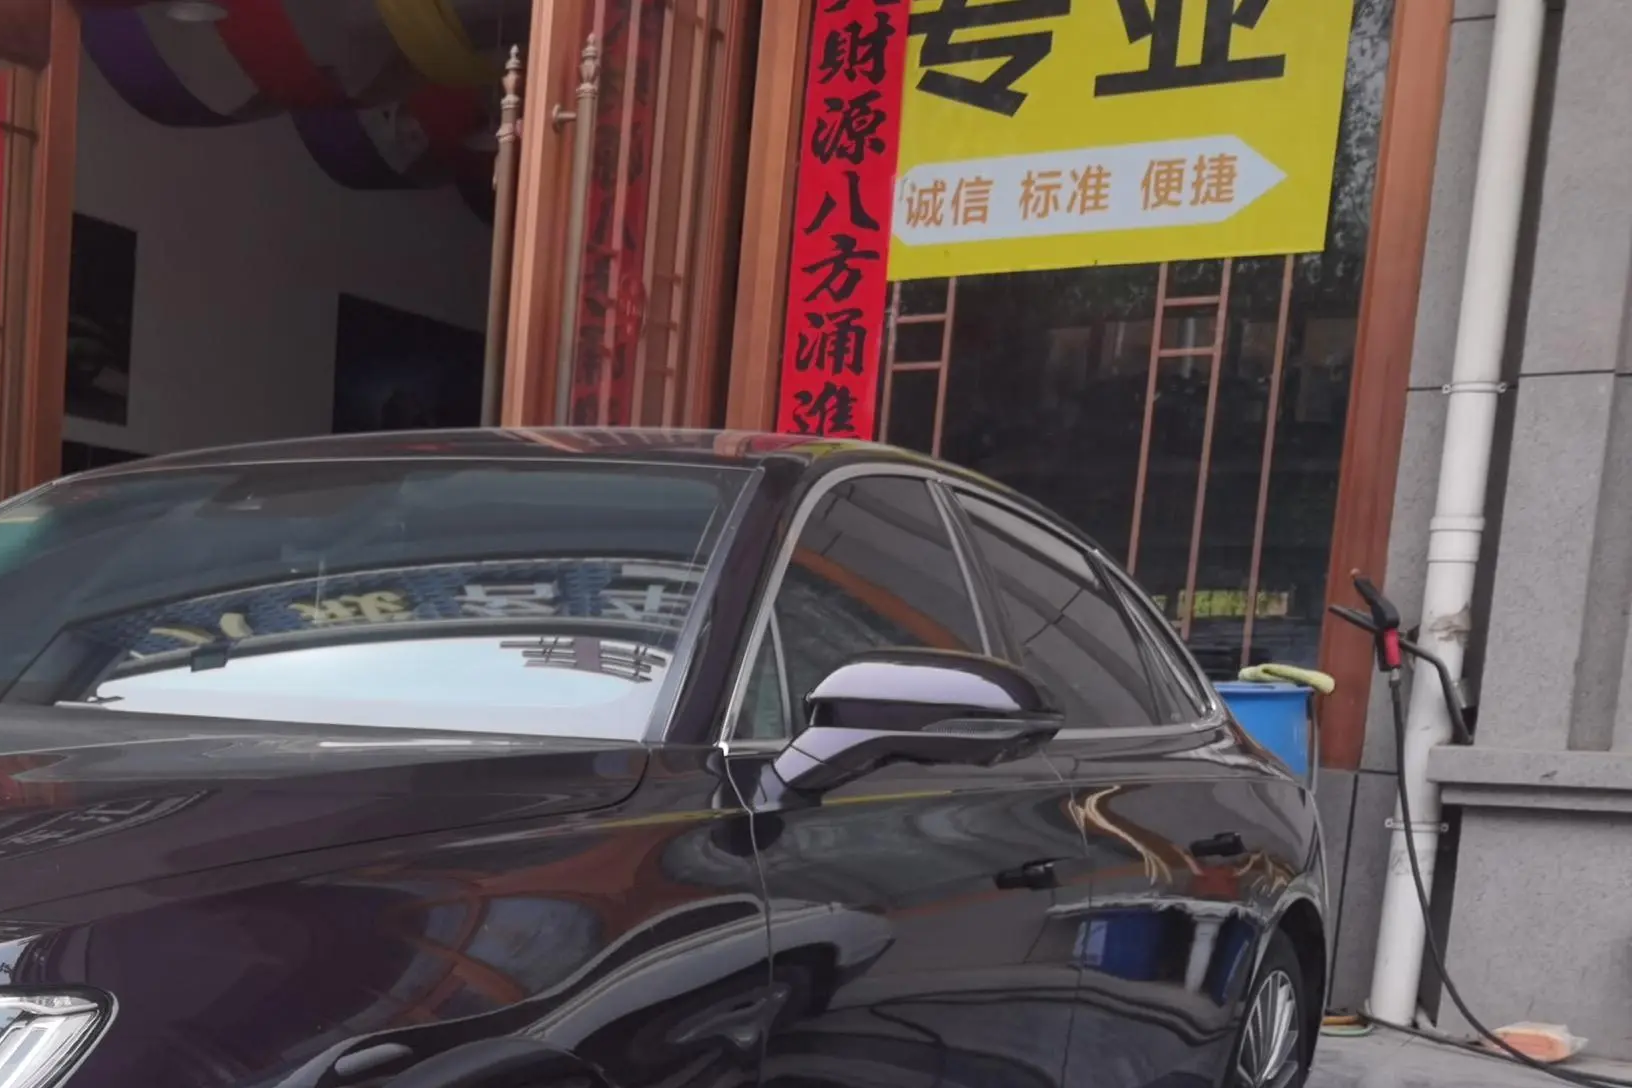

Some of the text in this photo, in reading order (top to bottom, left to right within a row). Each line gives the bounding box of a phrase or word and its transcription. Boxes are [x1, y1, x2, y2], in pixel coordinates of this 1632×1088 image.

[907, 0, 1286, 118] 专业
[905, 153, 1238, 228] 诚信 标准 便捷
